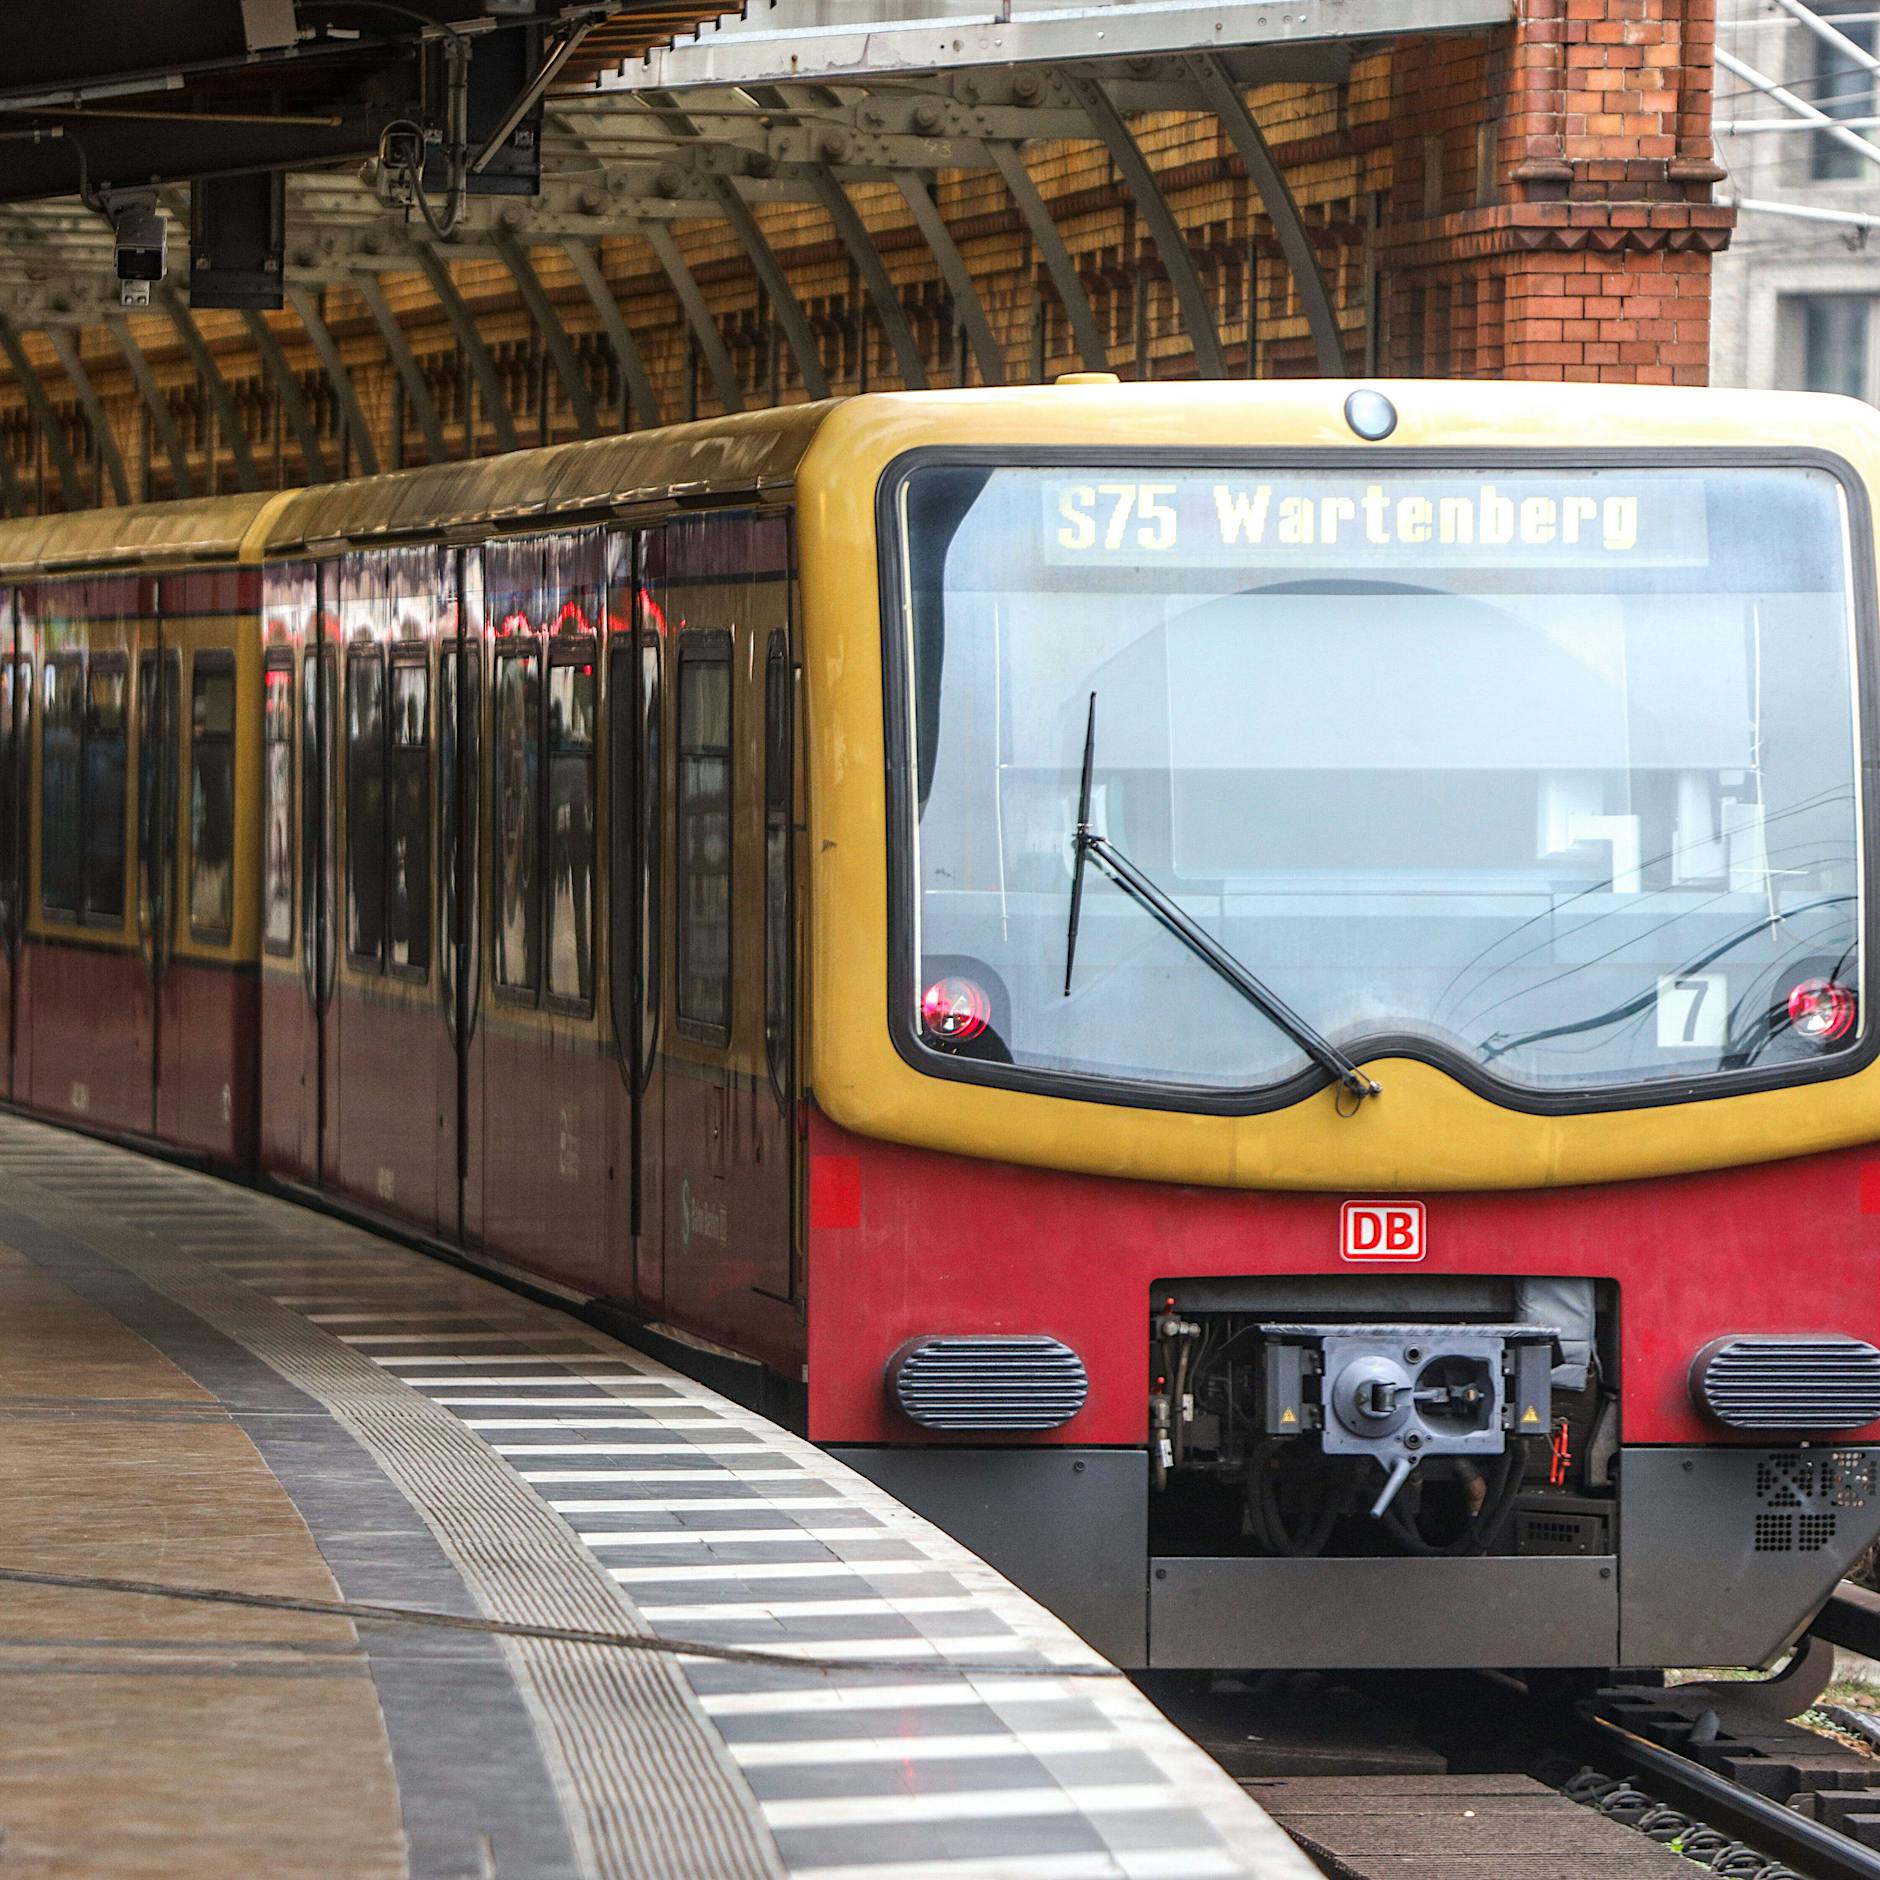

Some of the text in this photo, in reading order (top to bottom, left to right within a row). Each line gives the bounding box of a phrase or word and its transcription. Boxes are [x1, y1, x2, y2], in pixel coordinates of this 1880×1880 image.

[1058, 484, 1639, 551] S75 Wartenberg
[1675, 980, 1709, 1042] 7
[1353, 1211, 1414, 1251] DB
